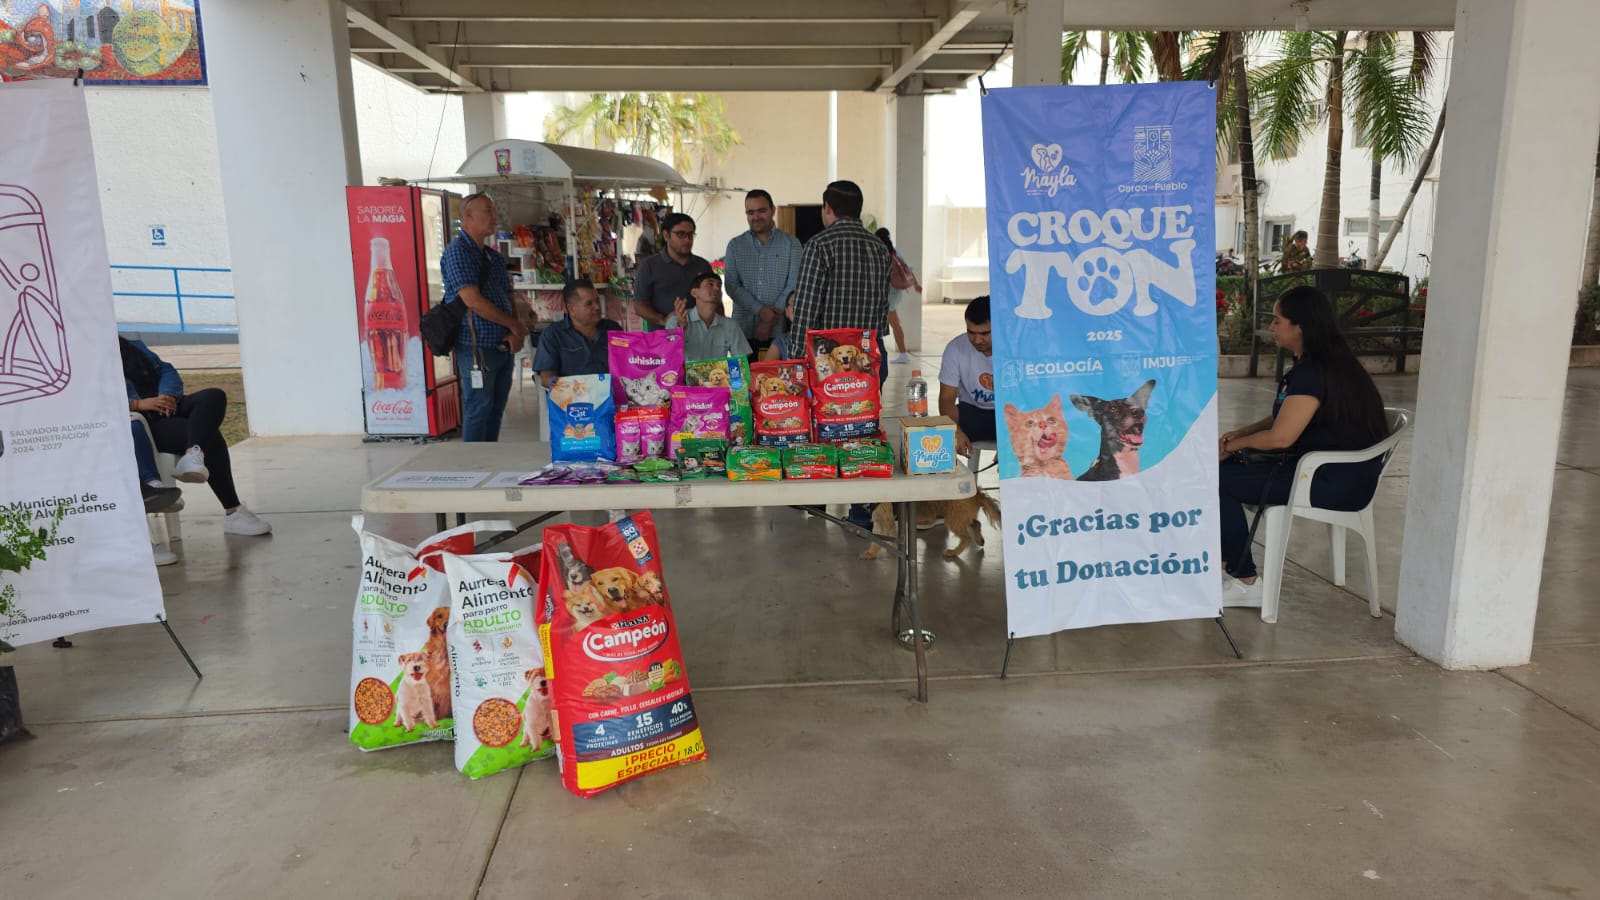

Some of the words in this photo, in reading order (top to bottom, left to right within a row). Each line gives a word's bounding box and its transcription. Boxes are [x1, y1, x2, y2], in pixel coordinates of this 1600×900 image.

[1020, 164, 1077, 198] Mayla
[1118, 184, 1148, 193] Cerca
[1154, 182, 1188, 191] Pueblo
[356, 205, 405, 215] SABOREA
[357, 215, 371, 224] LA
[372, 214, 407, 224] MAGIA
[1007, 204, 1194, 250] CROQUE
[1005, 238, 1197, 321] TON
[1087, 330, 1123, 342] 2025
[628, 355, 667, 366] whiskas
[1026, 358, 1104, 376] ECOLOGÍA
[1143, 356, 1176, 369] IMJU
[826, 379, 868, 392] Campeón
[569, 410, 587, 418] Cat
[762, 400, 799, 411] Campeón
[9, 426, 59, 437] SALVADOR
[61, 421, 108, 433] ALVARADO
[11, 431, 89, 446] ADMINISTRACIÓN
[14, 446, 34, 454] 2024
[41, 442, 62, 451] 2027
[913, 448, 951, 468] Mayla
[10, 494, 78, 512] Municipal
[82, 492, 98, 503] de
[35, 502, 117, 520] Alvradense
[1017, 508, 1140, 546] ¡Gracias
[1148, 508, 1203, 533] por
[1014, 568, 1050, 590] tu
[1056, 550, 1209, 584] Donación!
[361, 593, 408, 613] ADULTO
[462, 587, 534, 610] Alimento
[0, 608, 90, 627] doralvarado.gob.mx
[463, 610, 484, 620] para
[484, 603, 508, 616] perro
[463, 609, 521, 629] ADULTO
[589, 620, 666, 650] Campeón
[595, 723, 605, 735] 4
[635, 711, 653, 728] 15
[627, 722, 663, 737] BENEFICIOS
[610, 742, 644, 757] ADULTOS
[625, 743, 676, 766] ¡PRECIO
[617, 751, 681, 779] ESPECIAL!
